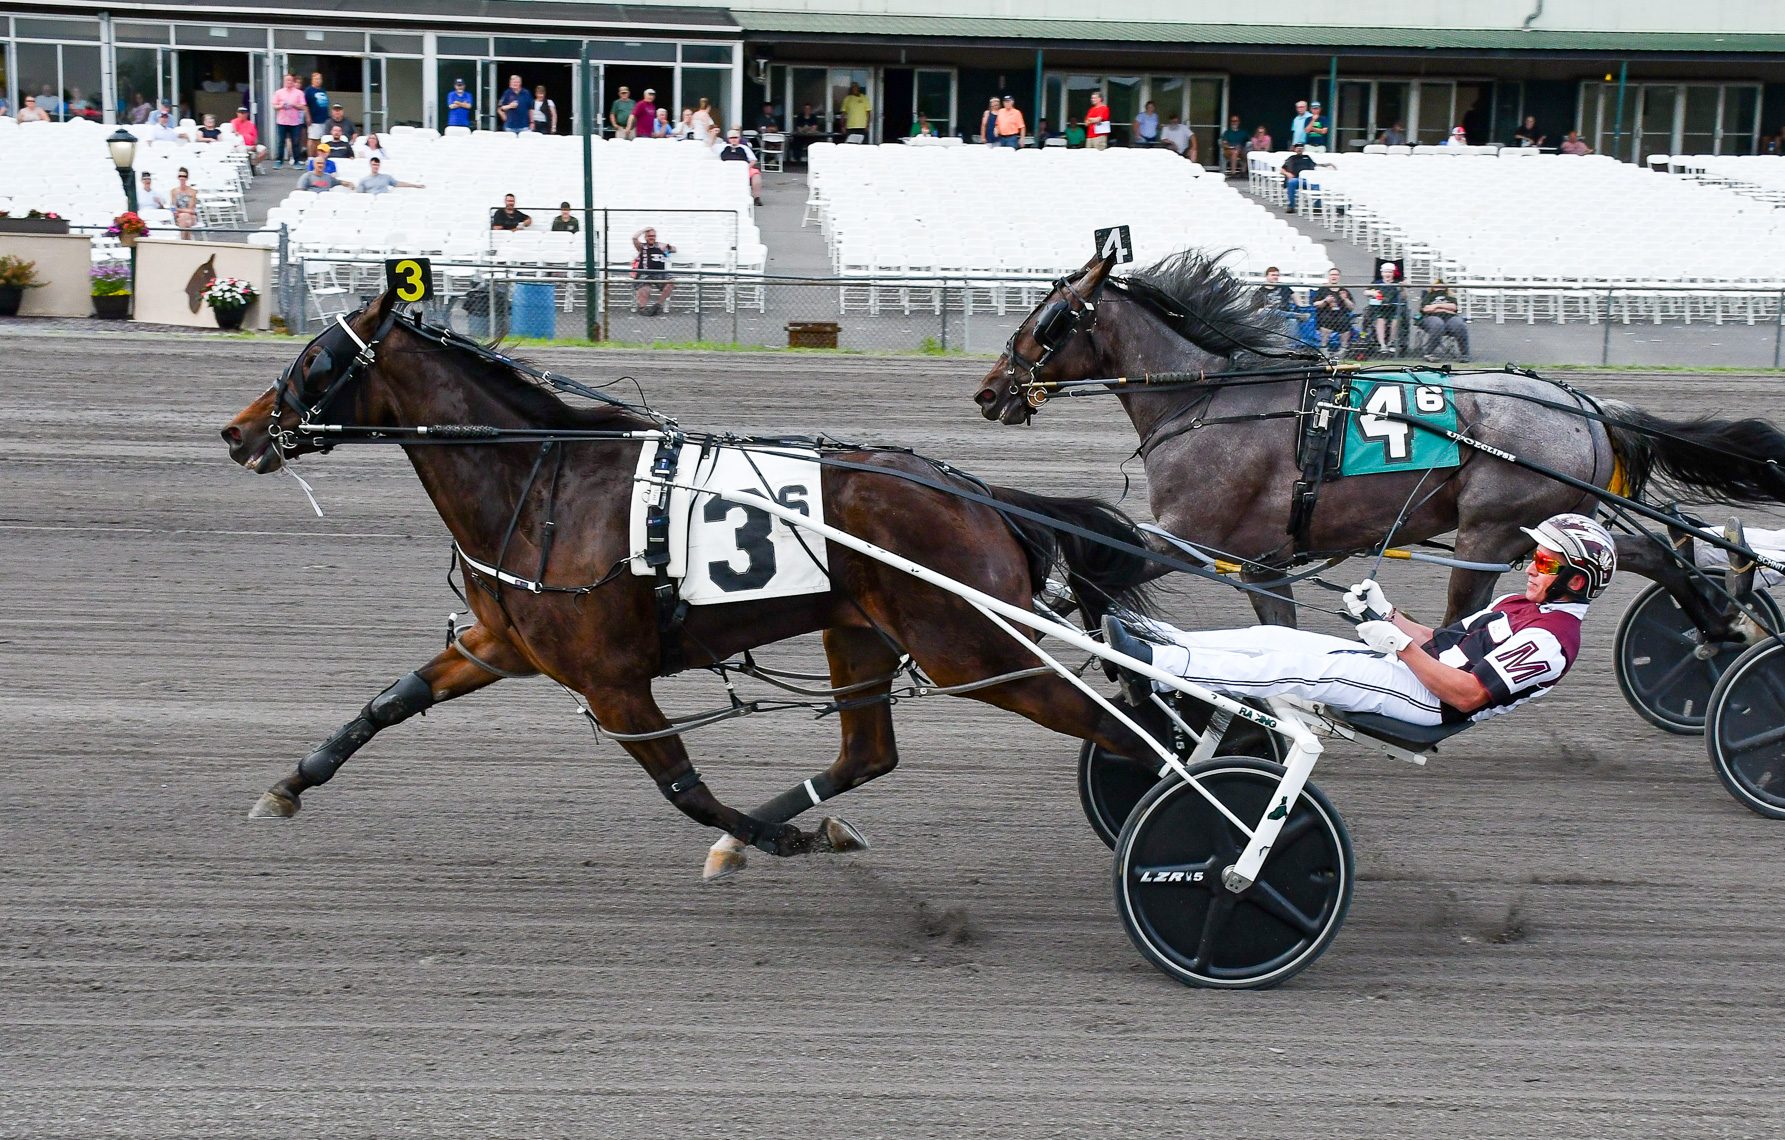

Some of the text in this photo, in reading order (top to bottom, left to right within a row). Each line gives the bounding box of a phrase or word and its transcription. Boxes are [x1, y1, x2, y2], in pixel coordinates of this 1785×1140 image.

[1102, 228, 1128, 264] 4
[395, 260, 425, 302] 3
[1357, 384, 1446, 462] 4 6
[704, 488, 777, 592] 3
[1495, 641, 1551, 684] M
